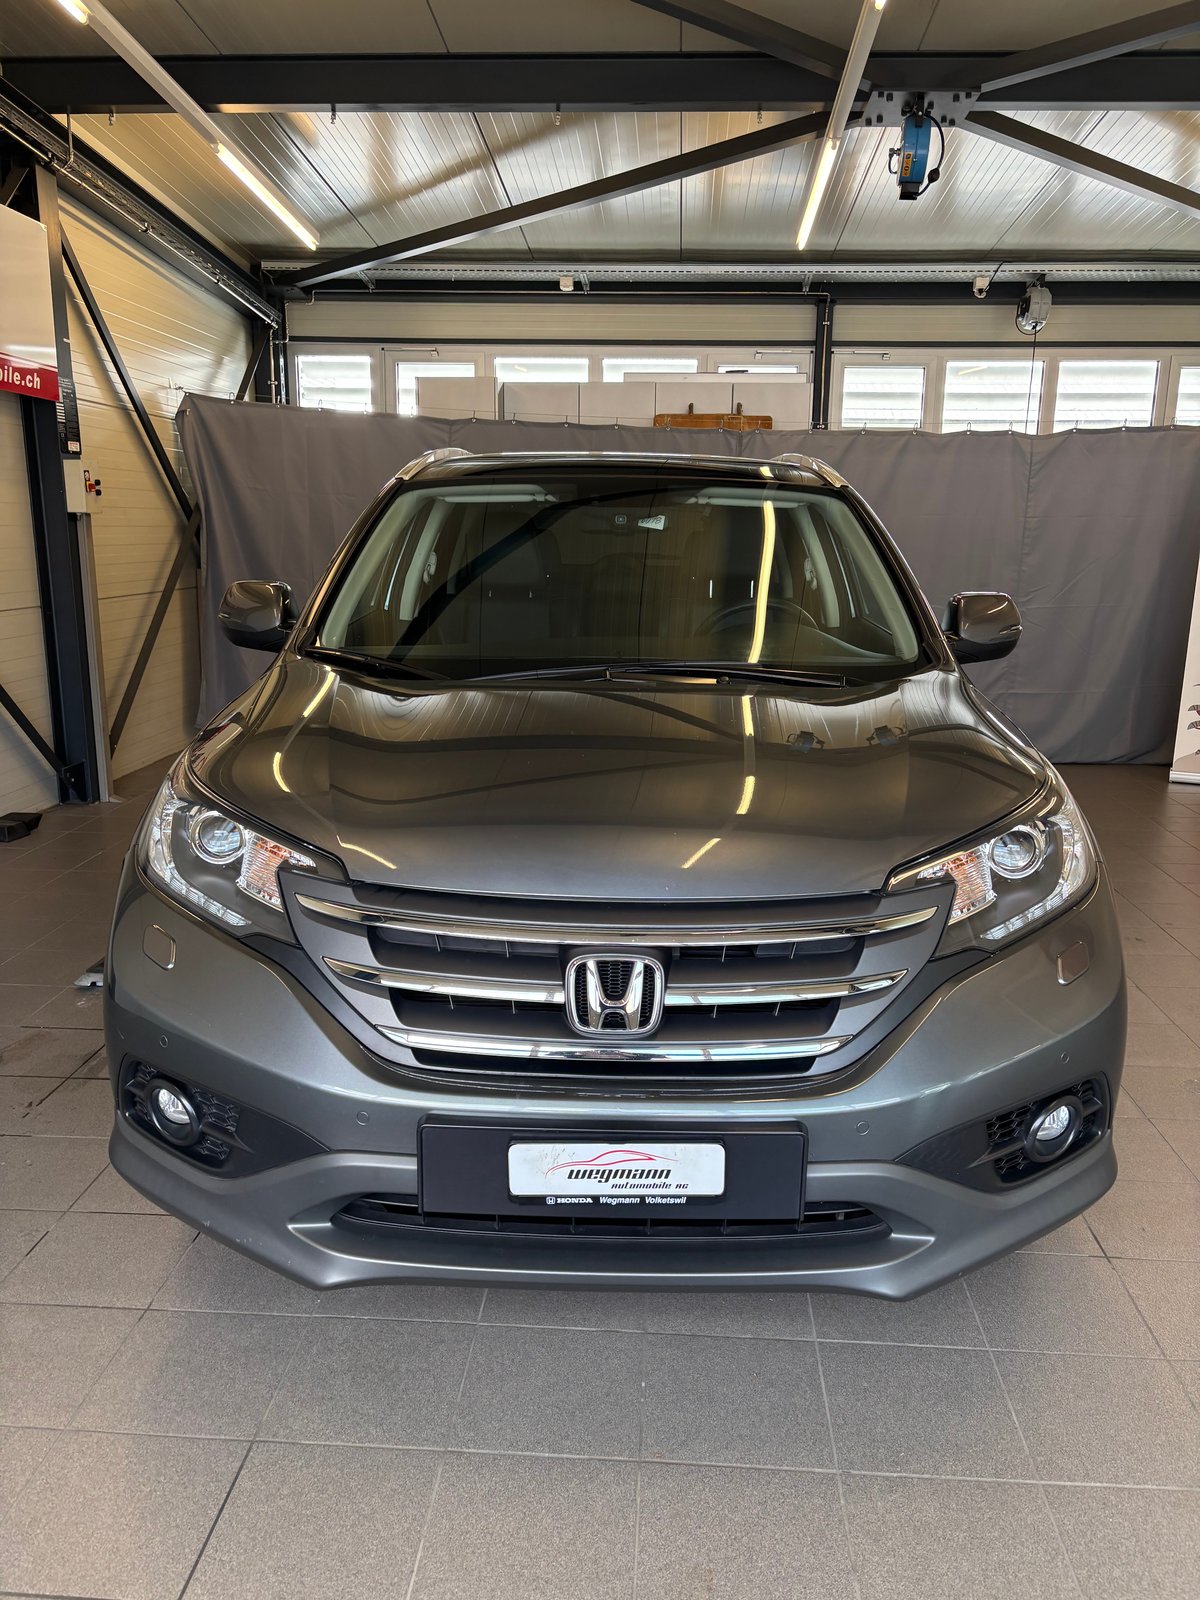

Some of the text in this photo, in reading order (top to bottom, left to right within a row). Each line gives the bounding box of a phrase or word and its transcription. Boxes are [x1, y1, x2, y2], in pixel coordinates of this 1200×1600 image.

[568, 1169, 672, 1183] wegmann
[599, 1196, 640, 1205] Wegmann
[645, 1196, 687, 1204] Volketswil
